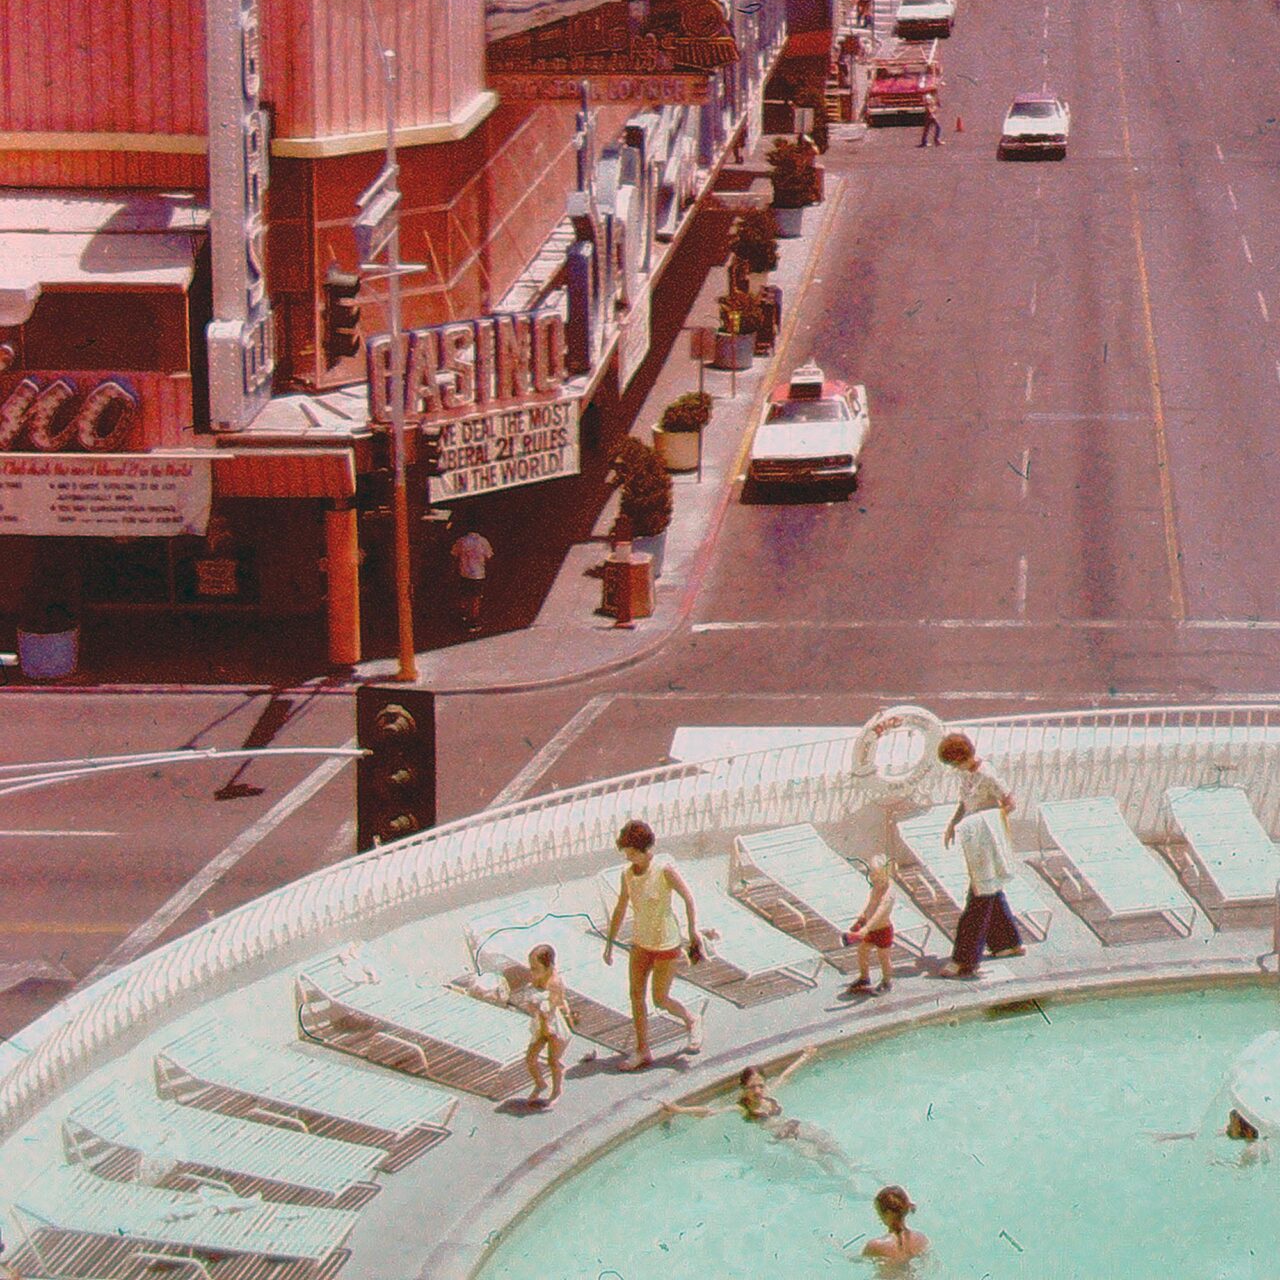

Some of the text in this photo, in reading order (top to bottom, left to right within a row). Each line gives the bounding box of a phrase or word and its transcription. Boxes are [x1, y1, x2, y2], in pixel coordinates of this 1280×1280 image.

[367, 311, 568, 419] CASINO
[461, 417, 495, 443] DEAL
[501, 411, 525, 435] THE
[529, 402, 571, 428] MOST
[442, 428, 568, 470] BERAL 21 RULES
[453, 472, 468, 493] IN
[472, 467, 497, 490] THE
